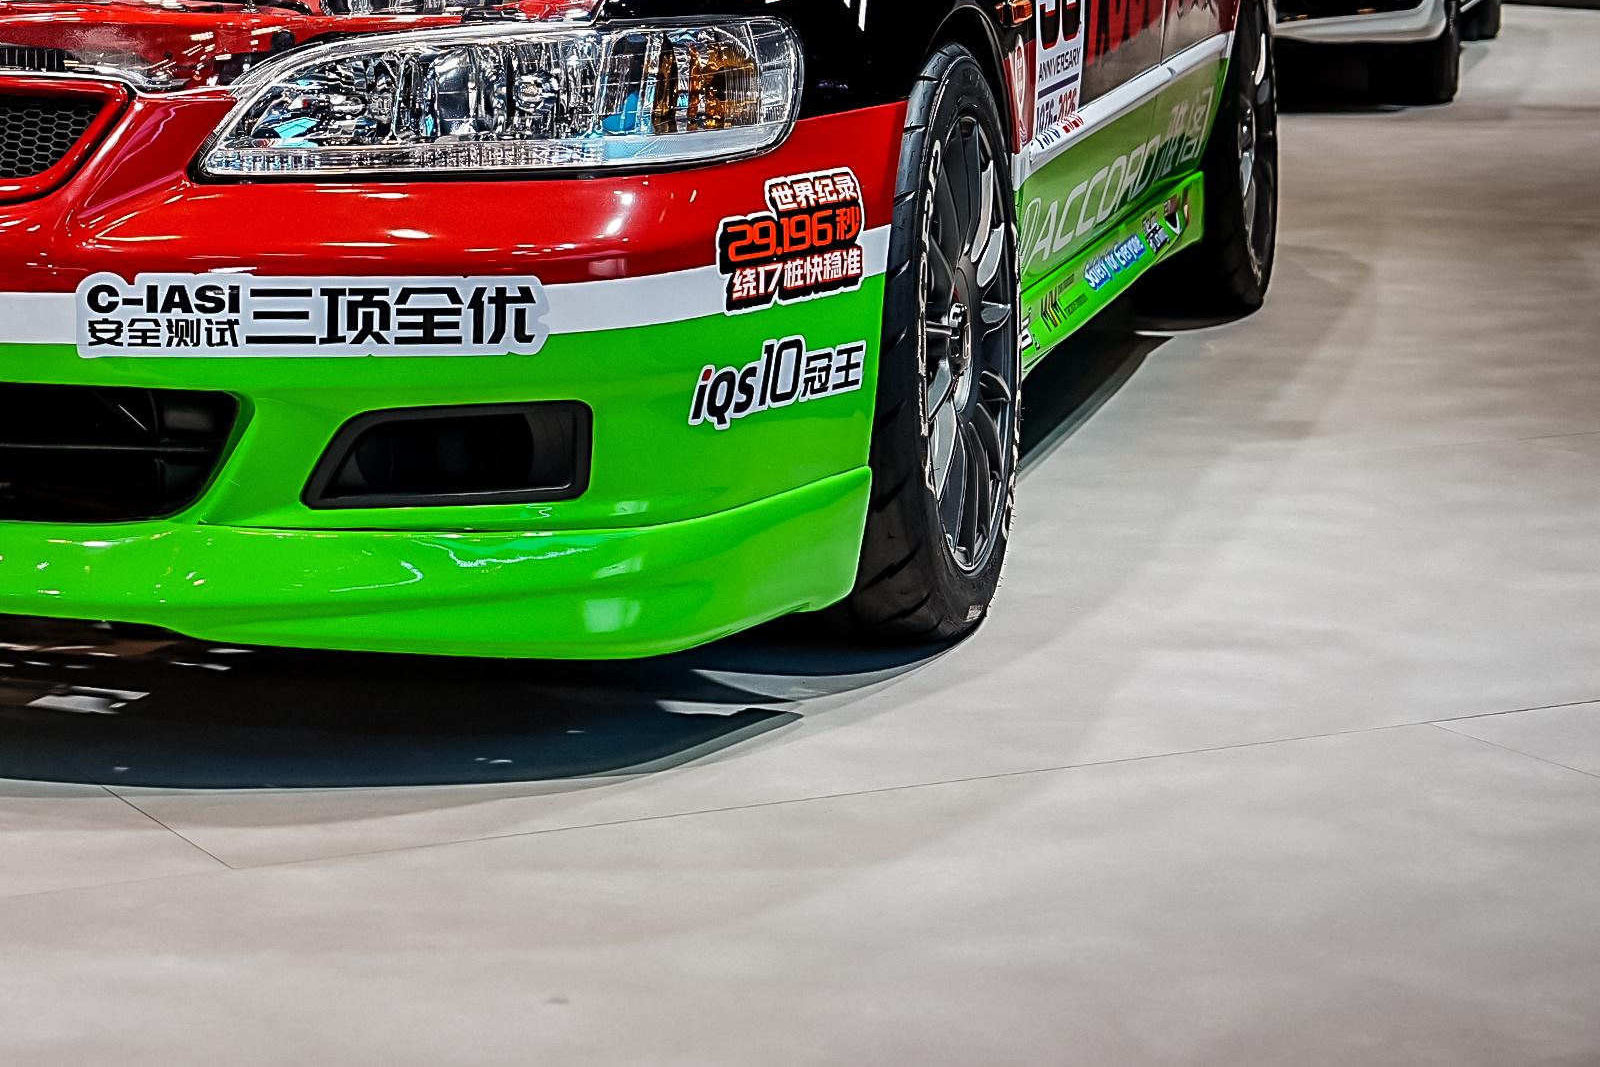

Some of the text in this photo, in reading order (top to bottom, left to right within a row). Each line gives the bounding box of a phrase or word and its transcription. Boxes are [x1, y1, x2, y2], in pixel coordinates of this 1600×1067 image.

[1038, 46, 1082, 83] ANNIVERSARY
[771, 174, 859, 211] 世界纪录
[731, 248, 862, 301] 绕17桩快稳准
[86, 284, 241, 315] C-IASI
[245, 285, 536, 346] 三项全优
[87, 318, 240, 349] 安全测试
